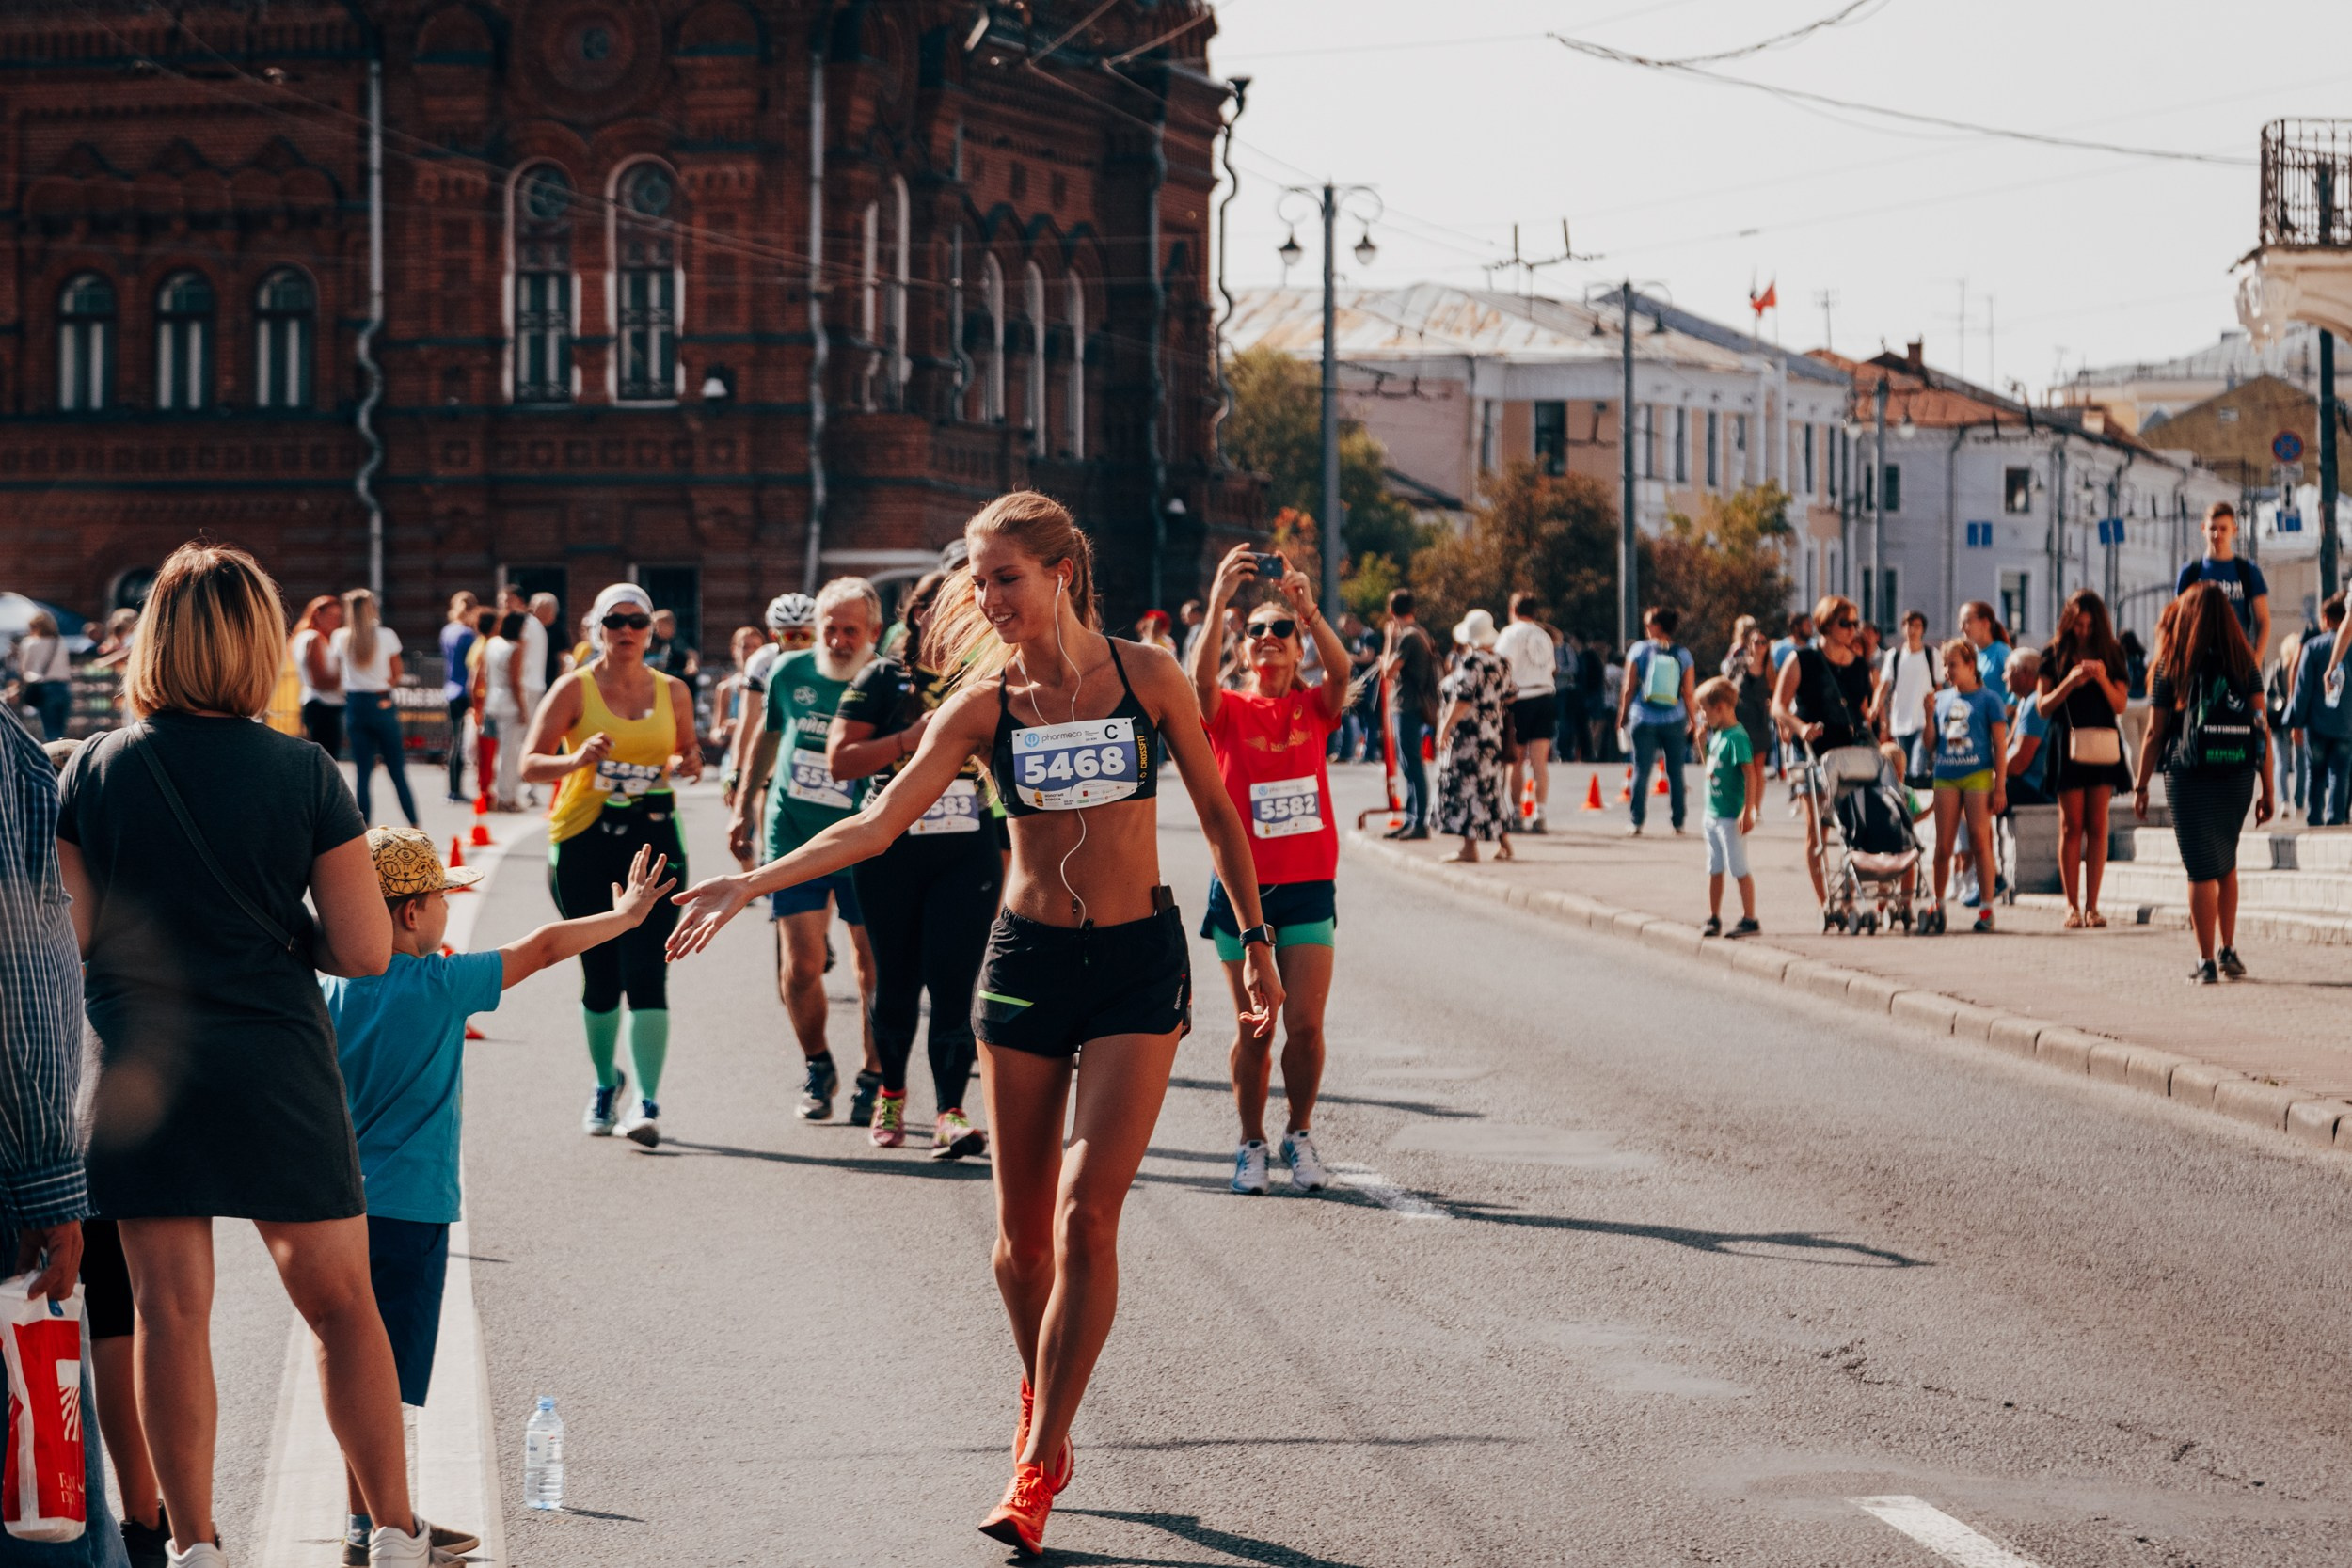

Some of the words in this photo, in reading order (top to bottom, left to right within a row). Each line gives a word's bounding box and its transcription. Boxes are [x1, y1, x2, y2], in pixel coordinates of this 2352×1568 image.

[1041, 730, 1082, 745] pharmeco
[1104, 724, 1119, 740] C
[1136, 735, 1148, 769] CROSSFIT
[1025, 746, 1126, 784] 5468
[922, 796, 972, 817] 583
[1261, 793, 1316, 820] 5582
